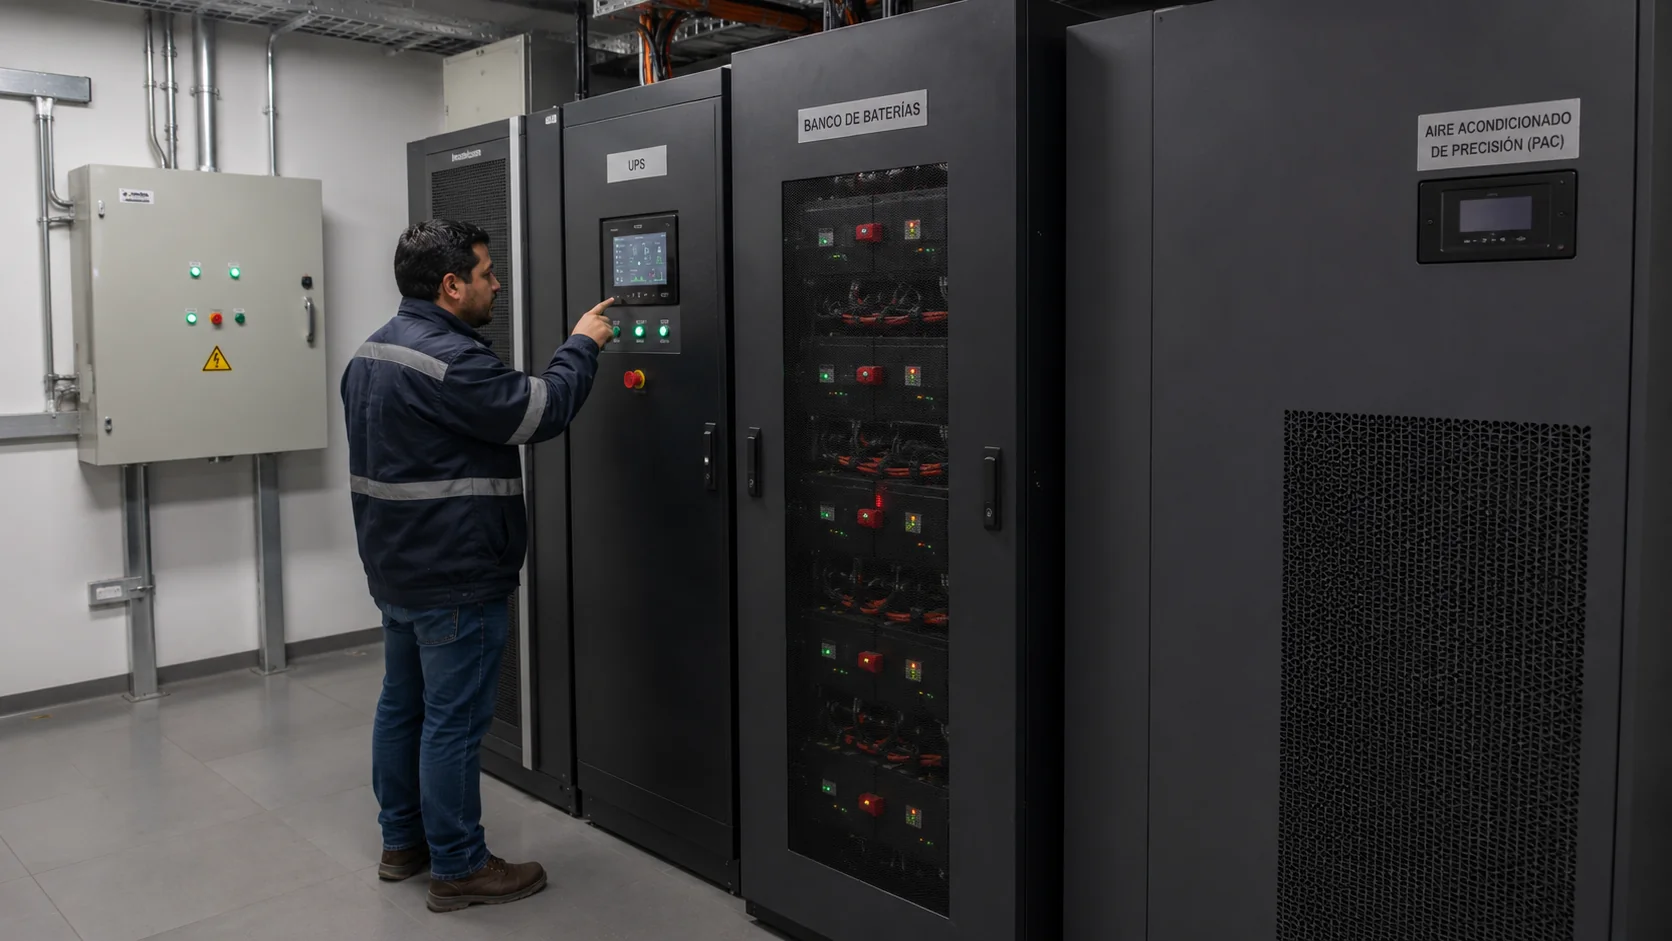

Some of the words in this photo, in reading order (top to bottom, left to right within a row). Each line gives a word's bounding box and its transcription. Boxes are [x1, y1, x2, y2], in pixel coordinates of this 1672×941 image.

[804, 114, 842, 132] BANCO
[845, 111, 860, 126] DE
[863, 101, 921, 123] BATERÍAS
[1425, 123, 1455, 138] AIRE
[1458, 111, 1572, 135] ACONDICIONADO
[1431, 145, 1448, 158] DE
[1451, 136, 1523, 157] PRECISIÓN
[1527, 134, 1565, 152] (PAC)
[628, 158, 646, 172] UPS
